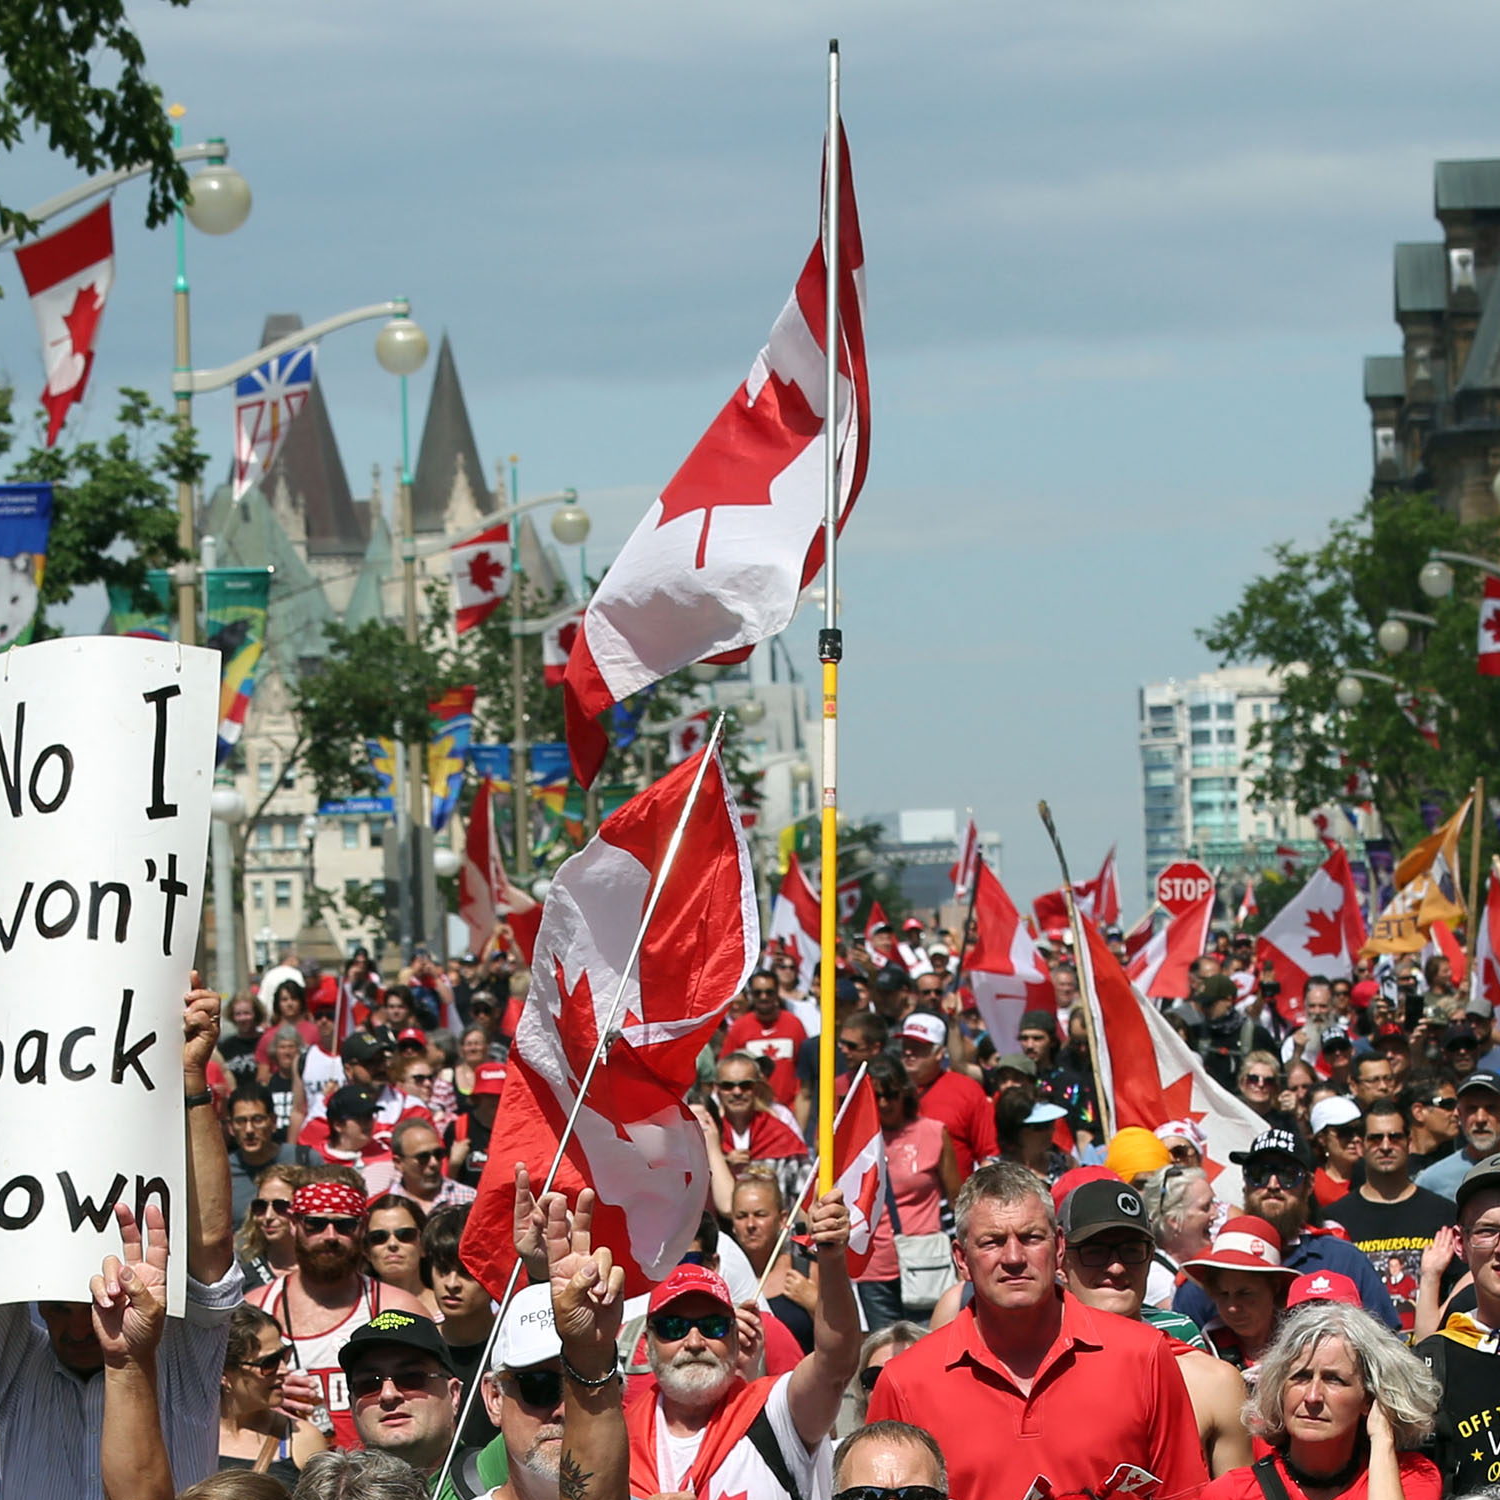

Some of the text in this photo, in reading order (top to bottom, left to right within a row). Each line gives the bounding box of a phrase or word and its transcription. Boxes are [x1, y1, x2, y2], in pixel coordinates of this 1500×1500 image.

[142, 684, 183, 820] I
[1160, 879, 1210, 901] STOP
[1457, 1408, 1493, 1439] OFF
